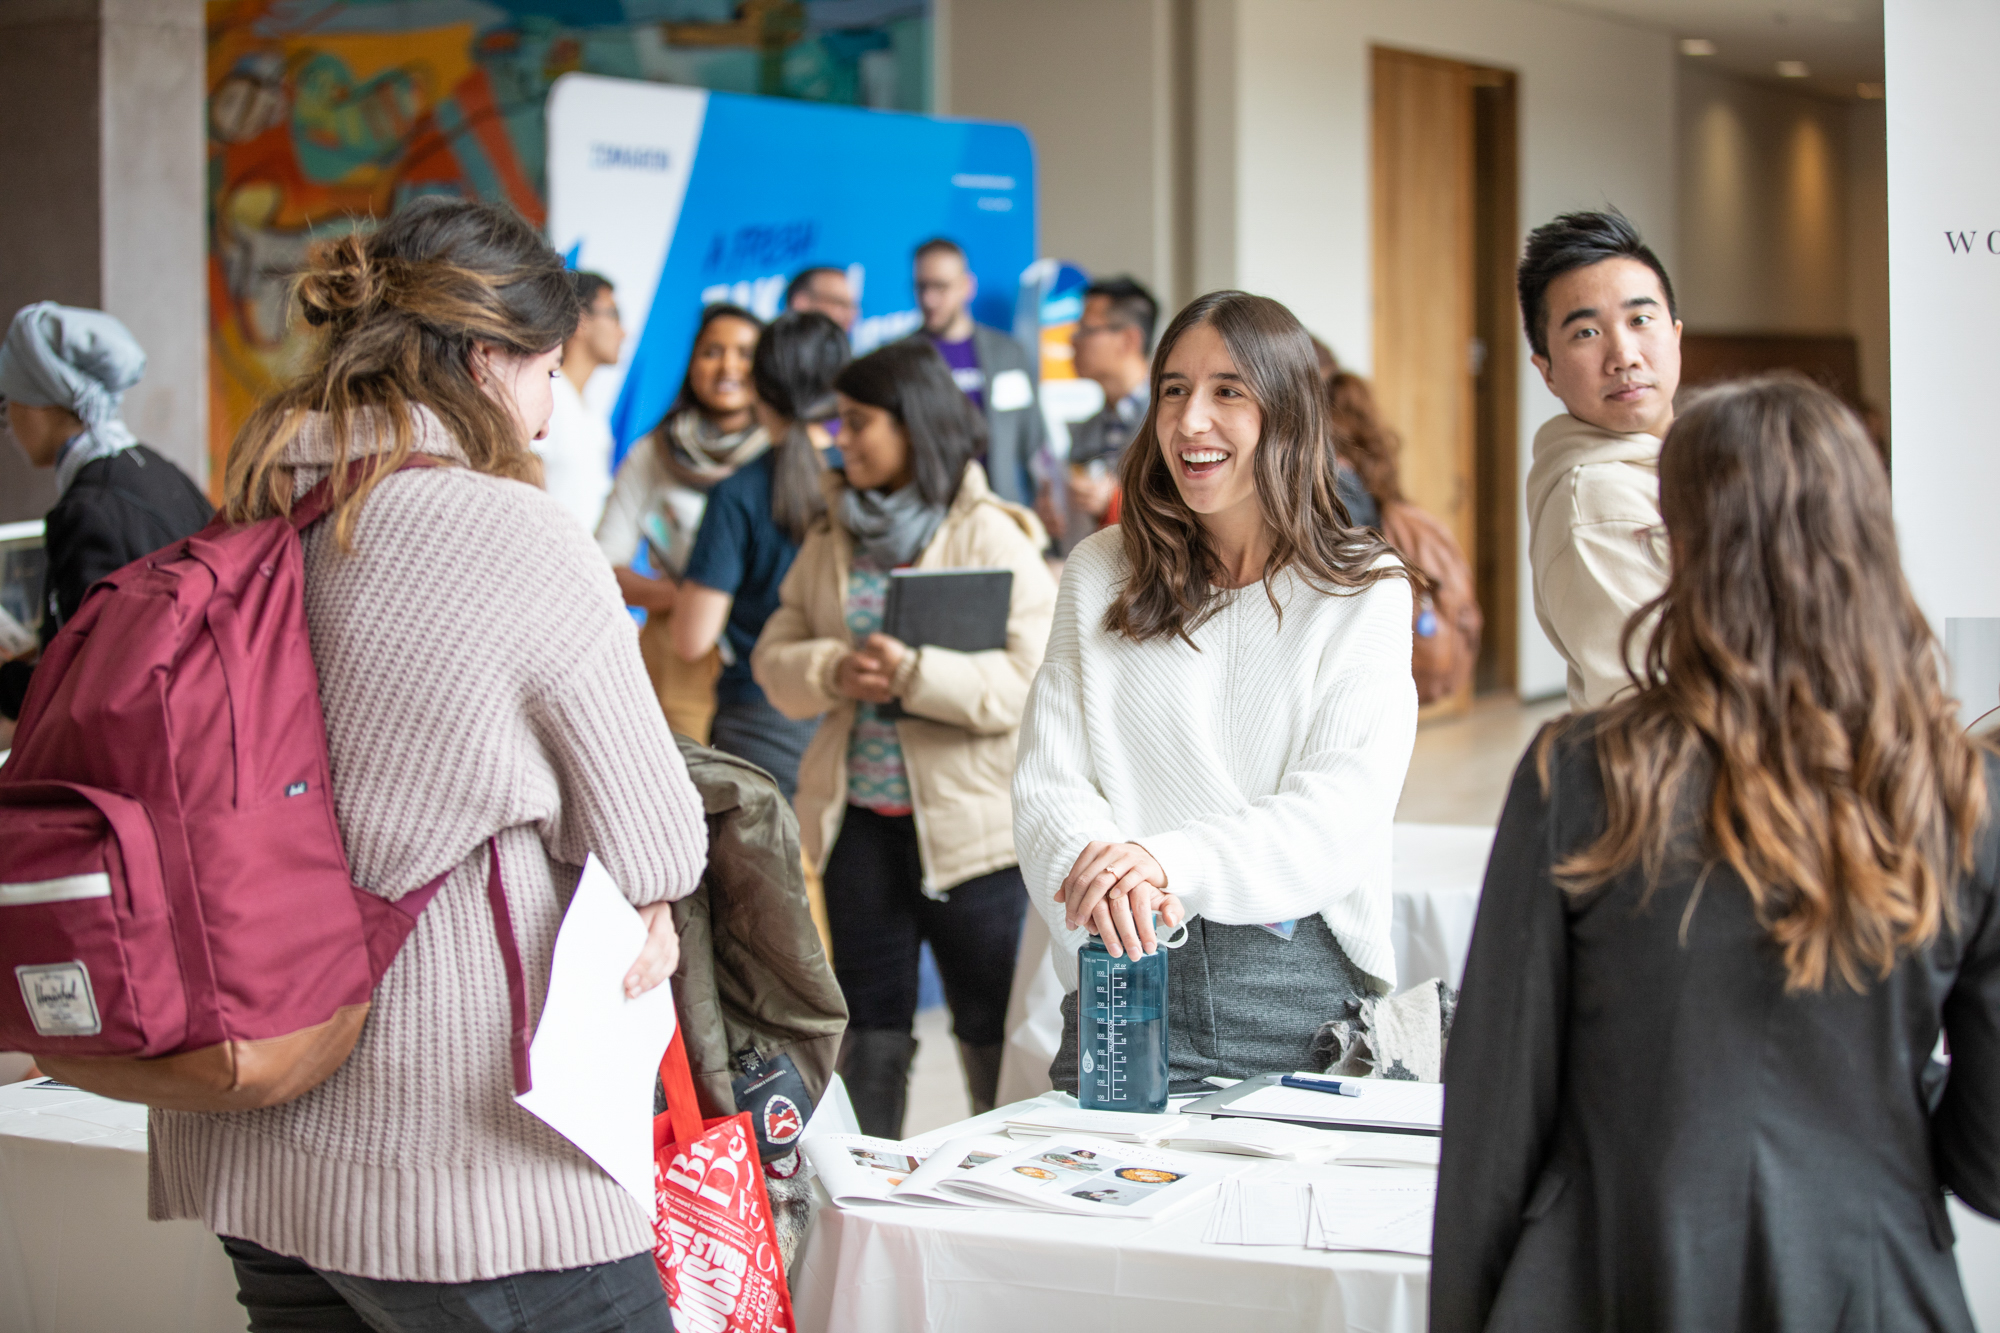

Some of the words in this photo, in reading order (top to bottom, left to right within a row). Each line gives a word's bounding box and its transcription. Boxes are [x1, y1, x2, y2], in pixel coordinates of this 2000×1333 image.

[669, 1206, 688, 1219] never
[687, 1214, 698, 1224] be
[697, 1220, 718, 1234] found
[674, 1196, 691, 1209] most
[690, 1203, 723, 1224] important
[689, 1232, 748, 1278] GOALS
[735, 1265, 755, 1325] strategy
[749, 1286, 760, 1311] not
[745, 1310, 754, 1321] a
